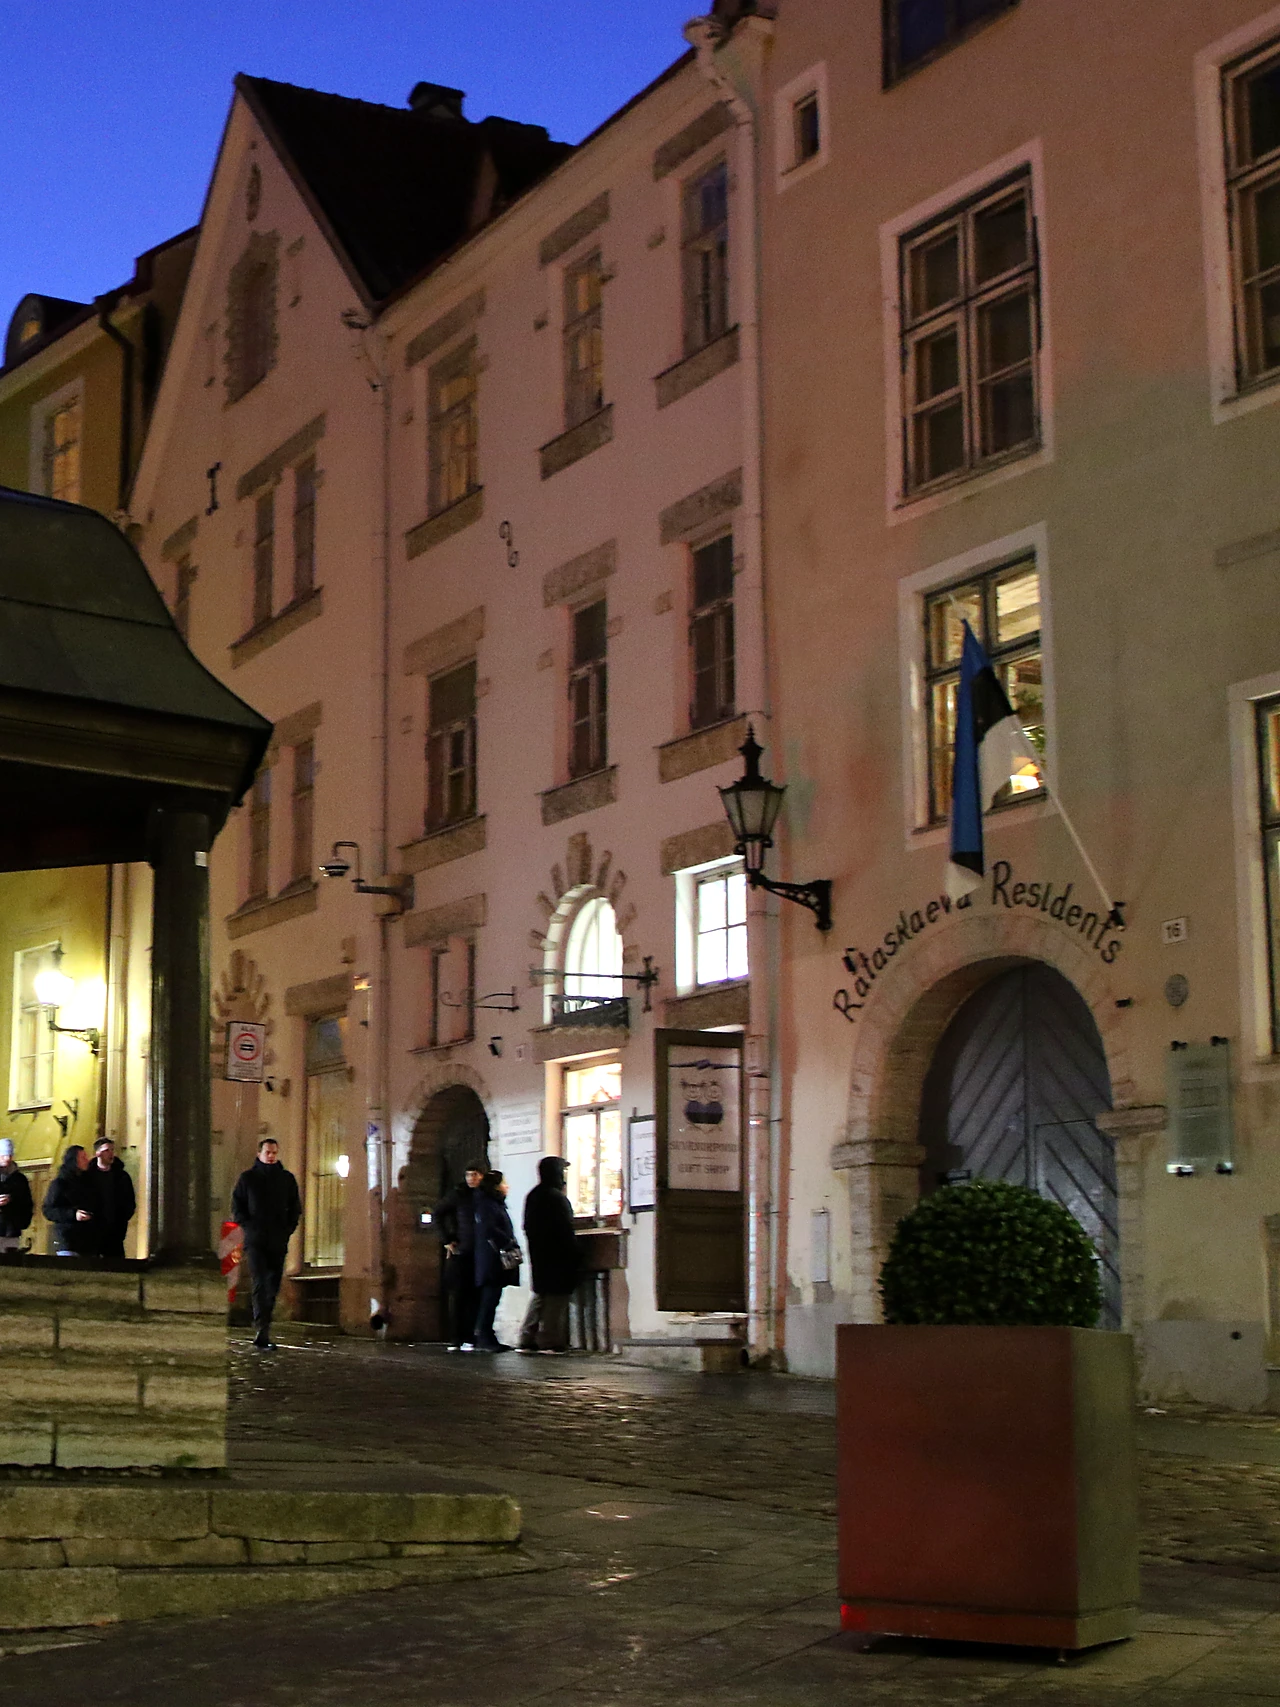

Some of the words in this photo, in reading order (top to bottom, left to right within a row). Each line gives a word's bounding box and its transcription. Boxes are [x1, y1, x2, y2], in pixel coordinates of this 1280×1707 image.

[1165, 922, 1182, 939] 16
[832, 893, 973, 1023] Rataskaeva
[991, 860, 1121, 964] Residents
[678, 1163, 701, 1173] GIFT
[704, 1164, 730, 1174] SHOP
